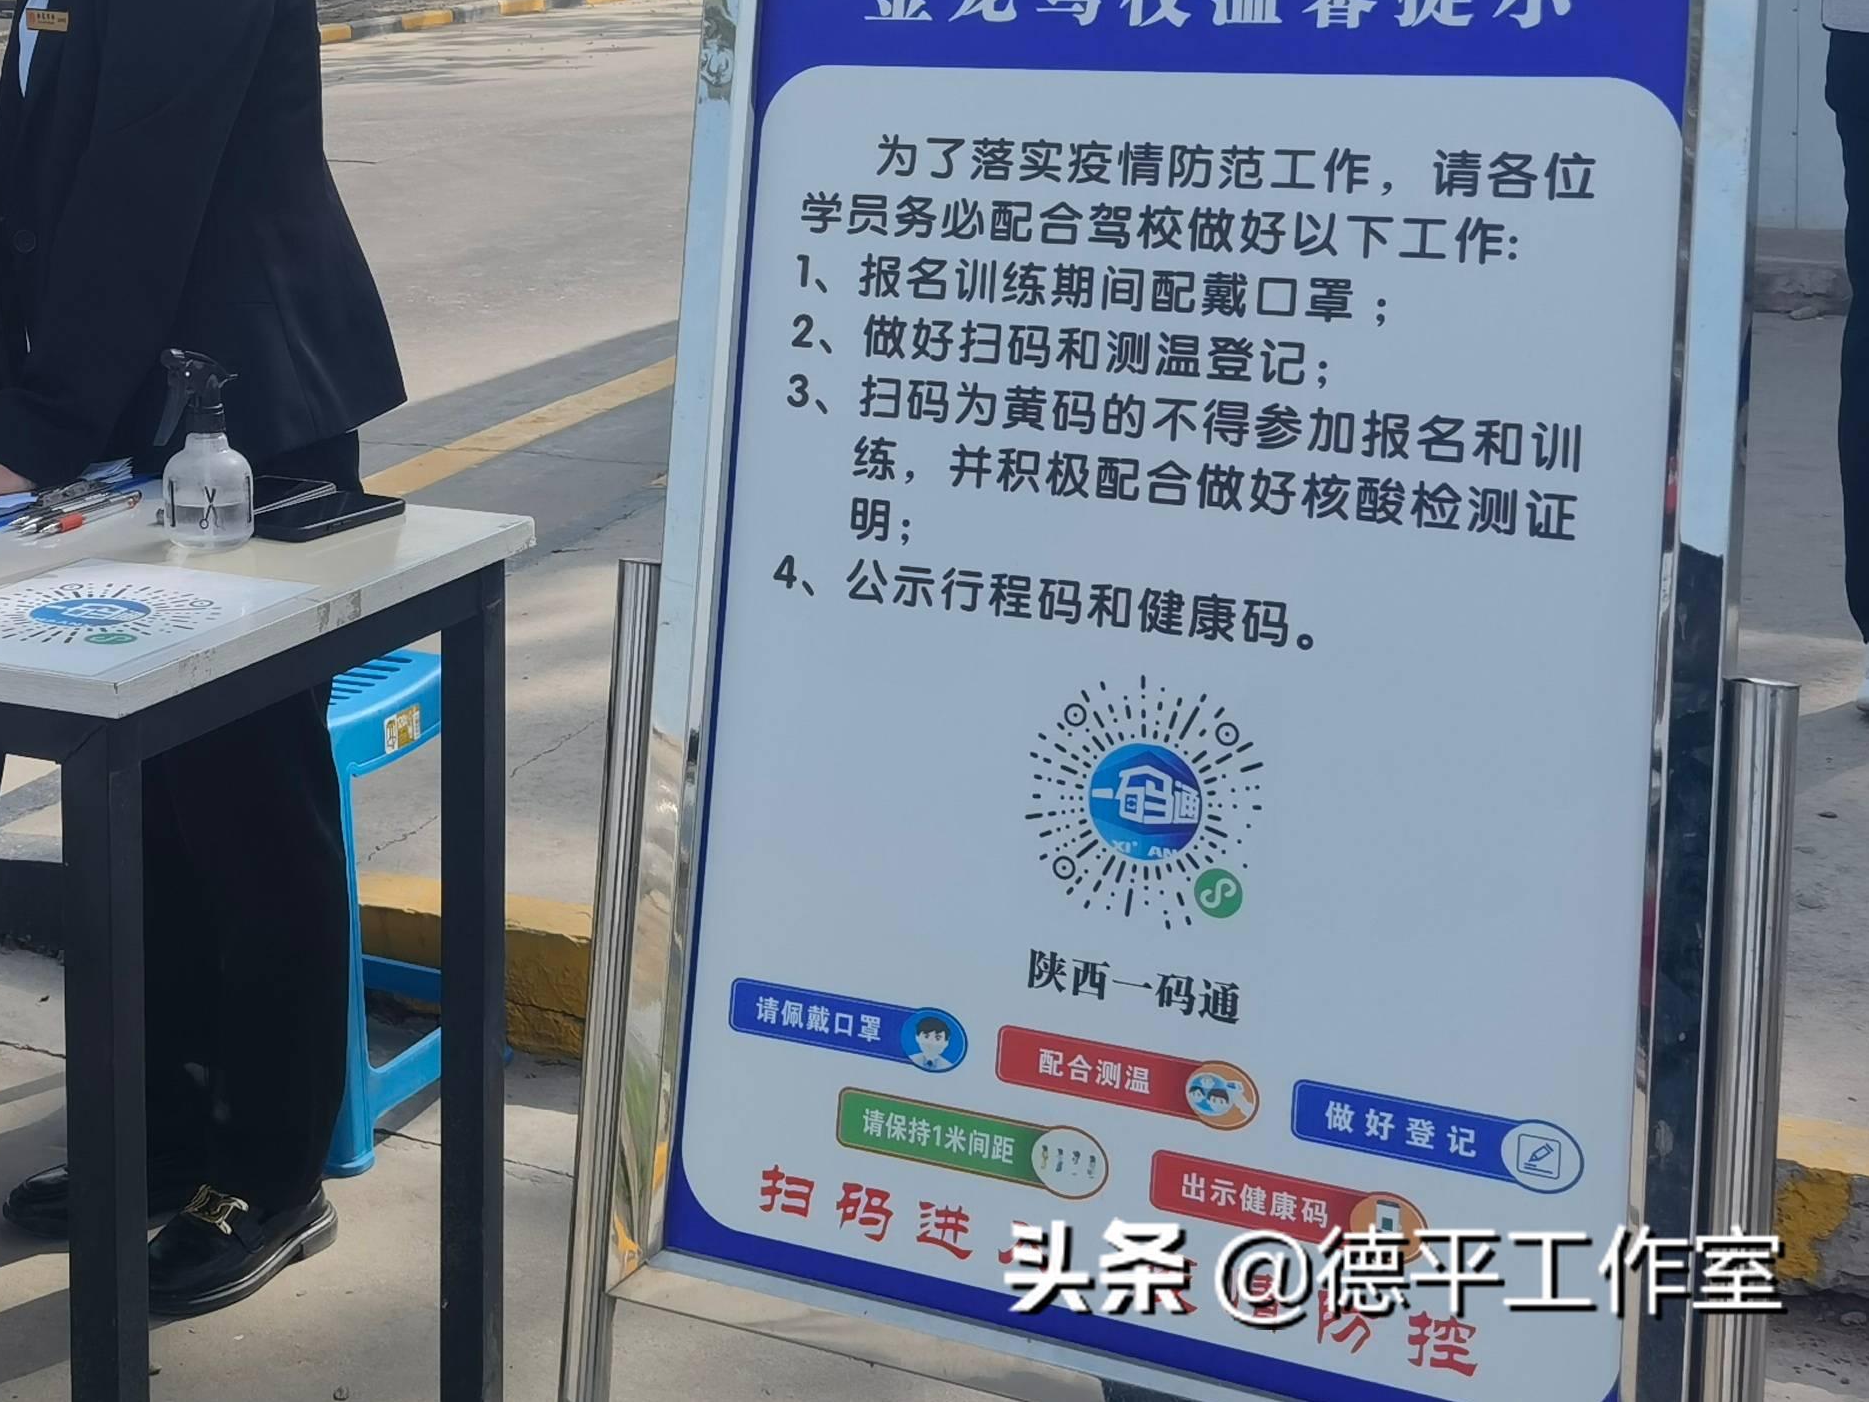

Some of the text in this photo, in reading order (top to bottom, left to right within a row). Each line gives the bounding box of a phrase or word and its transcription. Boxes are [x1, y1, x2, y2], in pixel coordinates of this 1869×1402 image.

[801, 190, 1520, 265] 学员务必配合驾校做好以下工作：
[1026, 945, 1243, 1028] 陕西一码通
[755, 995, 882, 1044] 请佩戴口罩
[1037, 1047, 1151, 1095] 配合测温
[862, 1106, 1016, 1165] 请保持1米间距
[1324, 1099, 1477, 1159] 做好登记
[1180, 1171, 1329, 1229] 出示健康码
